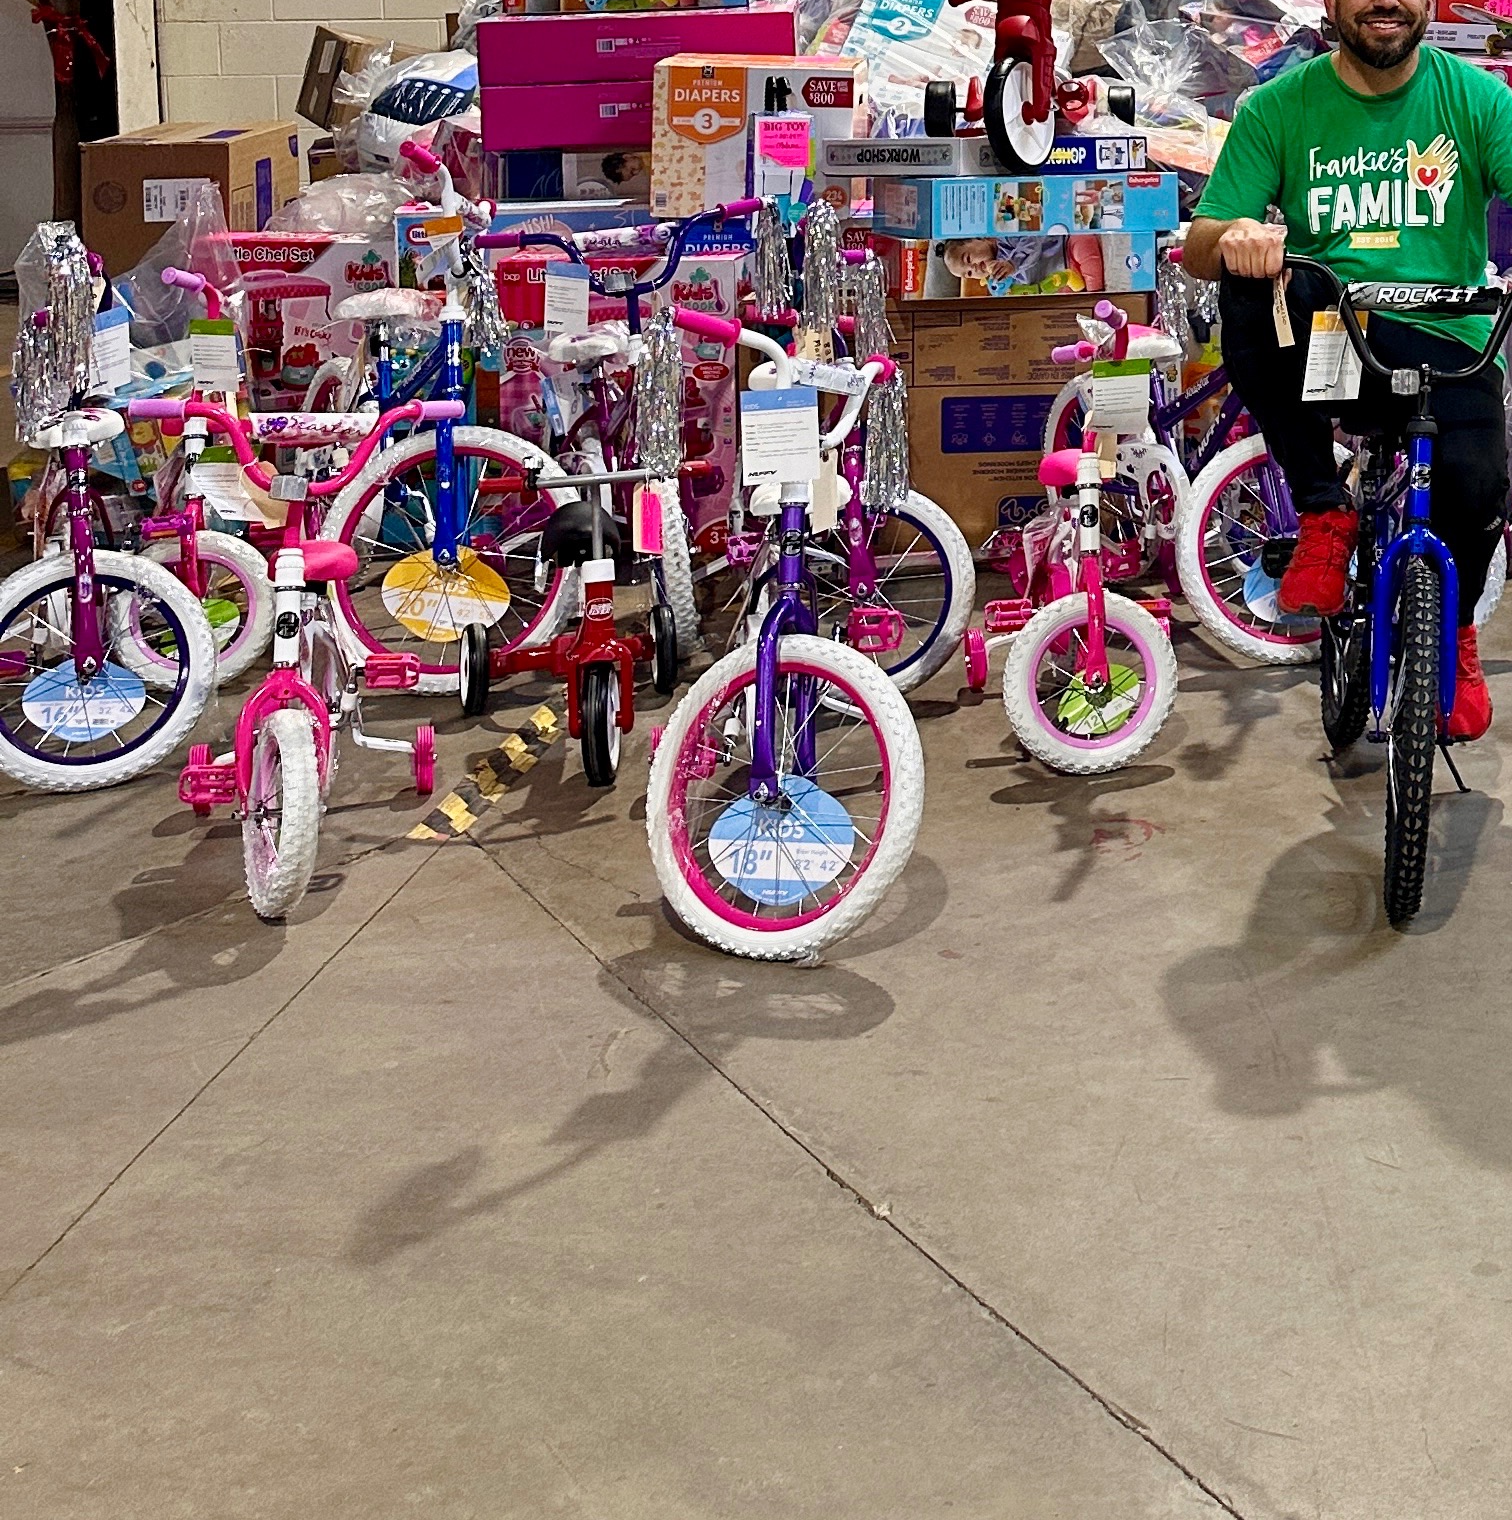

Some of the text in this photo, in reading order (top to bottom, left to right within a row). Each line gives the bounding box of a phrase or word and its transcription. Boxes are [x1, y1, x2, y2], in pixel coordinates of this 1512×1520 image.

[880, 0, 935, 18] DIAPERS
[895, 20, 905, 31] 2
[809, 81, 837, 91] SAVE
[674, 89, 740, 103] DIAPERS
[809, 93, 834, 104] $800
[701, 113, 713, 129] 3
[763, 121, 807, 131] BIG TOY
[856, 148, 921, 163] WORKSHOP
[1309, 146, 1407, 182] Frankie's
[1307, 180, 1454, 234] FAMILY
[846, 233, 869, 242] SAV
[254, 247, 315, 261] Chef Set
[347, 262, 385, 282] Kids
[671, 283, 714, 301] Kids
[506, 346, 536, 358] new
[65, 684, 105, 699] KIDS
[757, 818, 806, 839] KIDS
[730, 849, 772, 875] 18"
